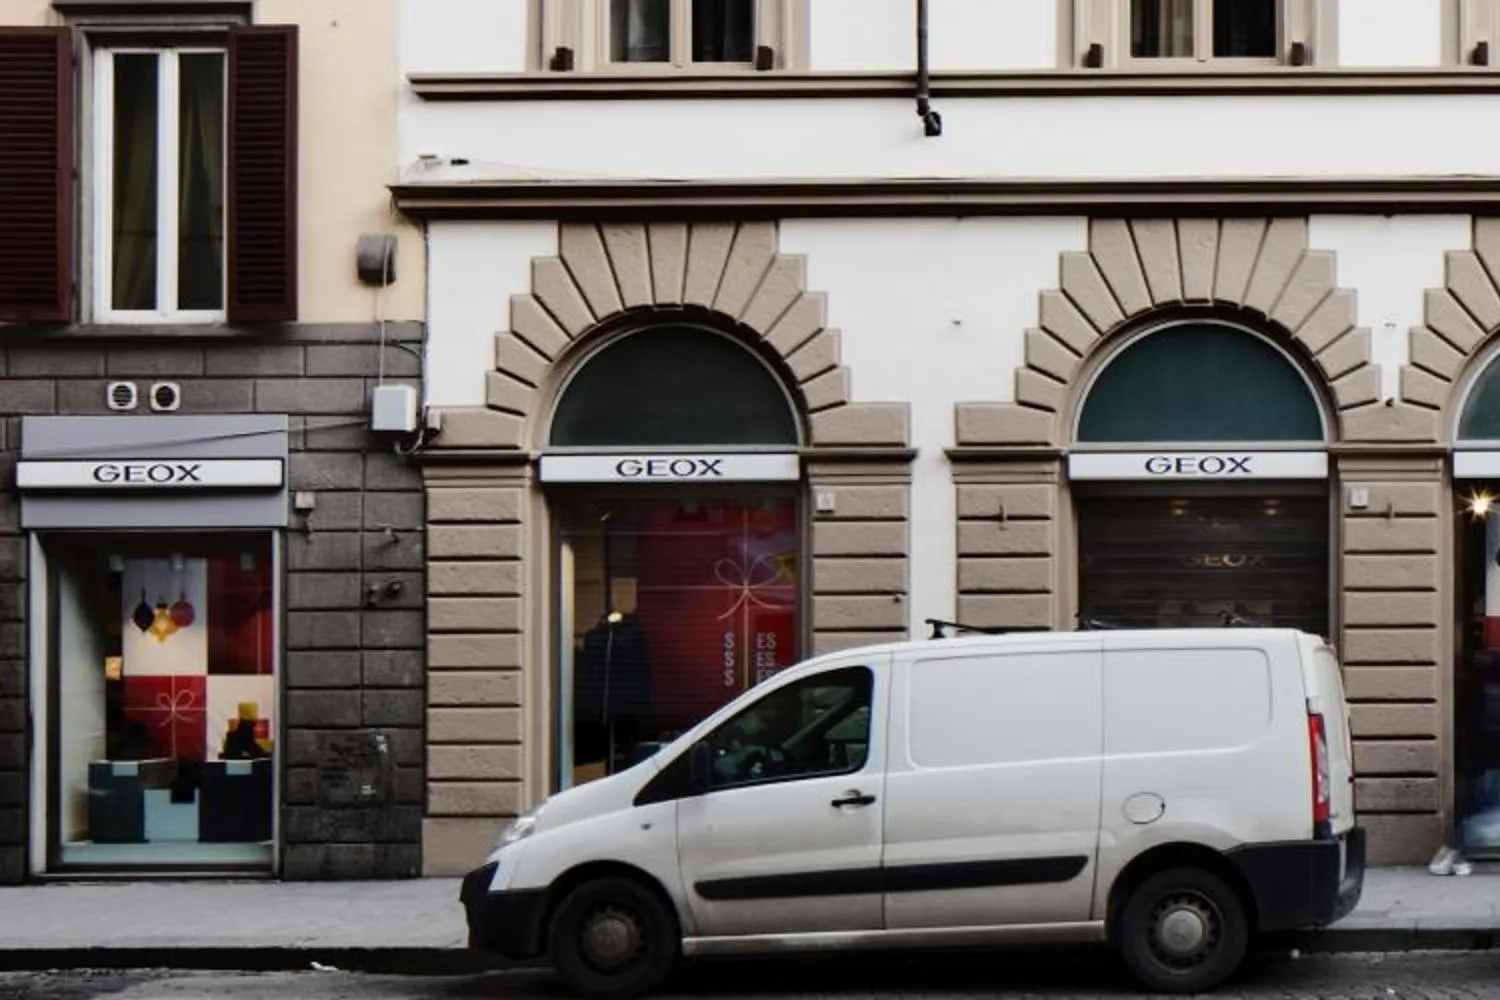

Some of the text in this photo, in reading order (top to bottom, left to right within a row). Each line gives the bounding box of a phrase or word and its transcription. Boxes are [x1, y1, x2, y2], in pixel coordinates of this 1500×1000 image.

[93, 464, 202, 482] GEOX
[616, 459, 723, 477] GEOX
[1145, 456, 1252, 474] GEOX
